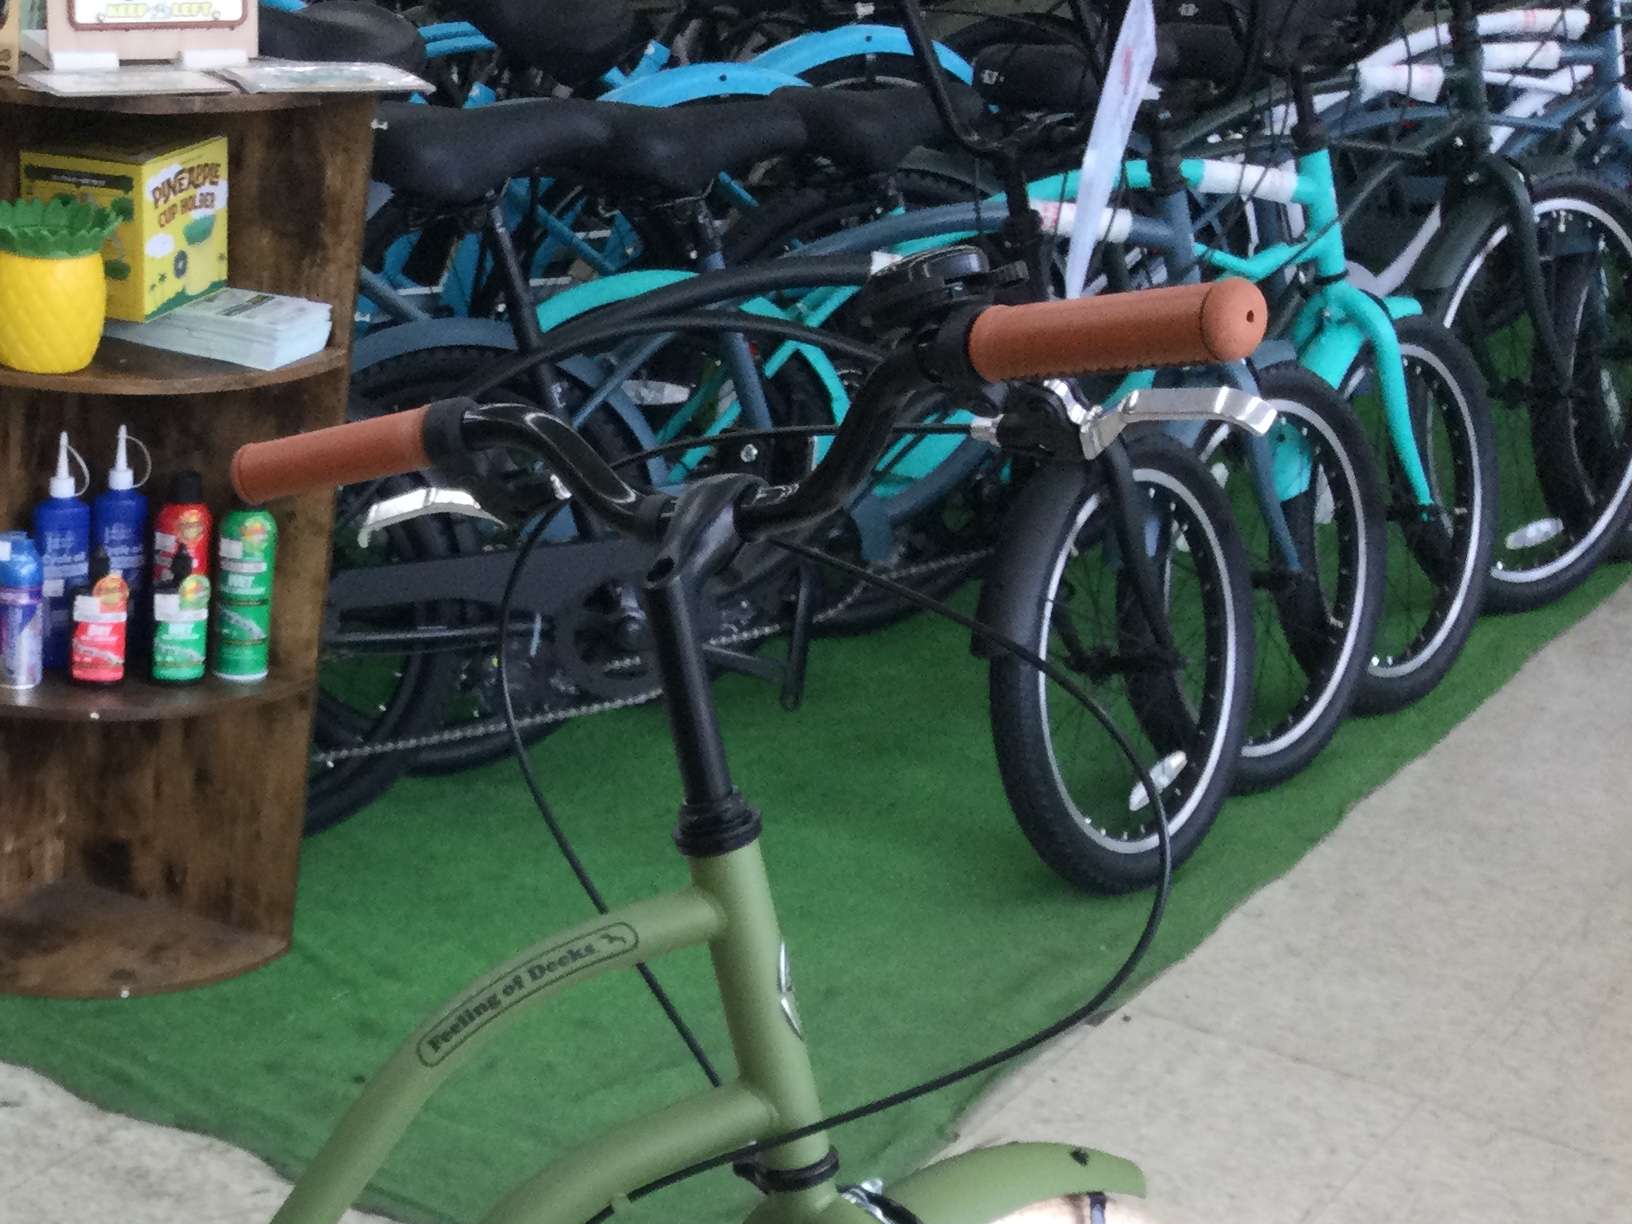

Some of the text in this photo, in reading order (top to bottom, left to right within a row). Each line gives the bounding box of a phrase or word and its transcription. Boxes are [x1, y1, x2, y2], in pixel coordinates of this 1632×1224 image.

[152, 162, 221, 208] PINEAPPLE
[159, 192, 215, 228] CUP HOLDER
[427, 993, 501, 1052] Feeling
[502, 975, 524, 996] of
